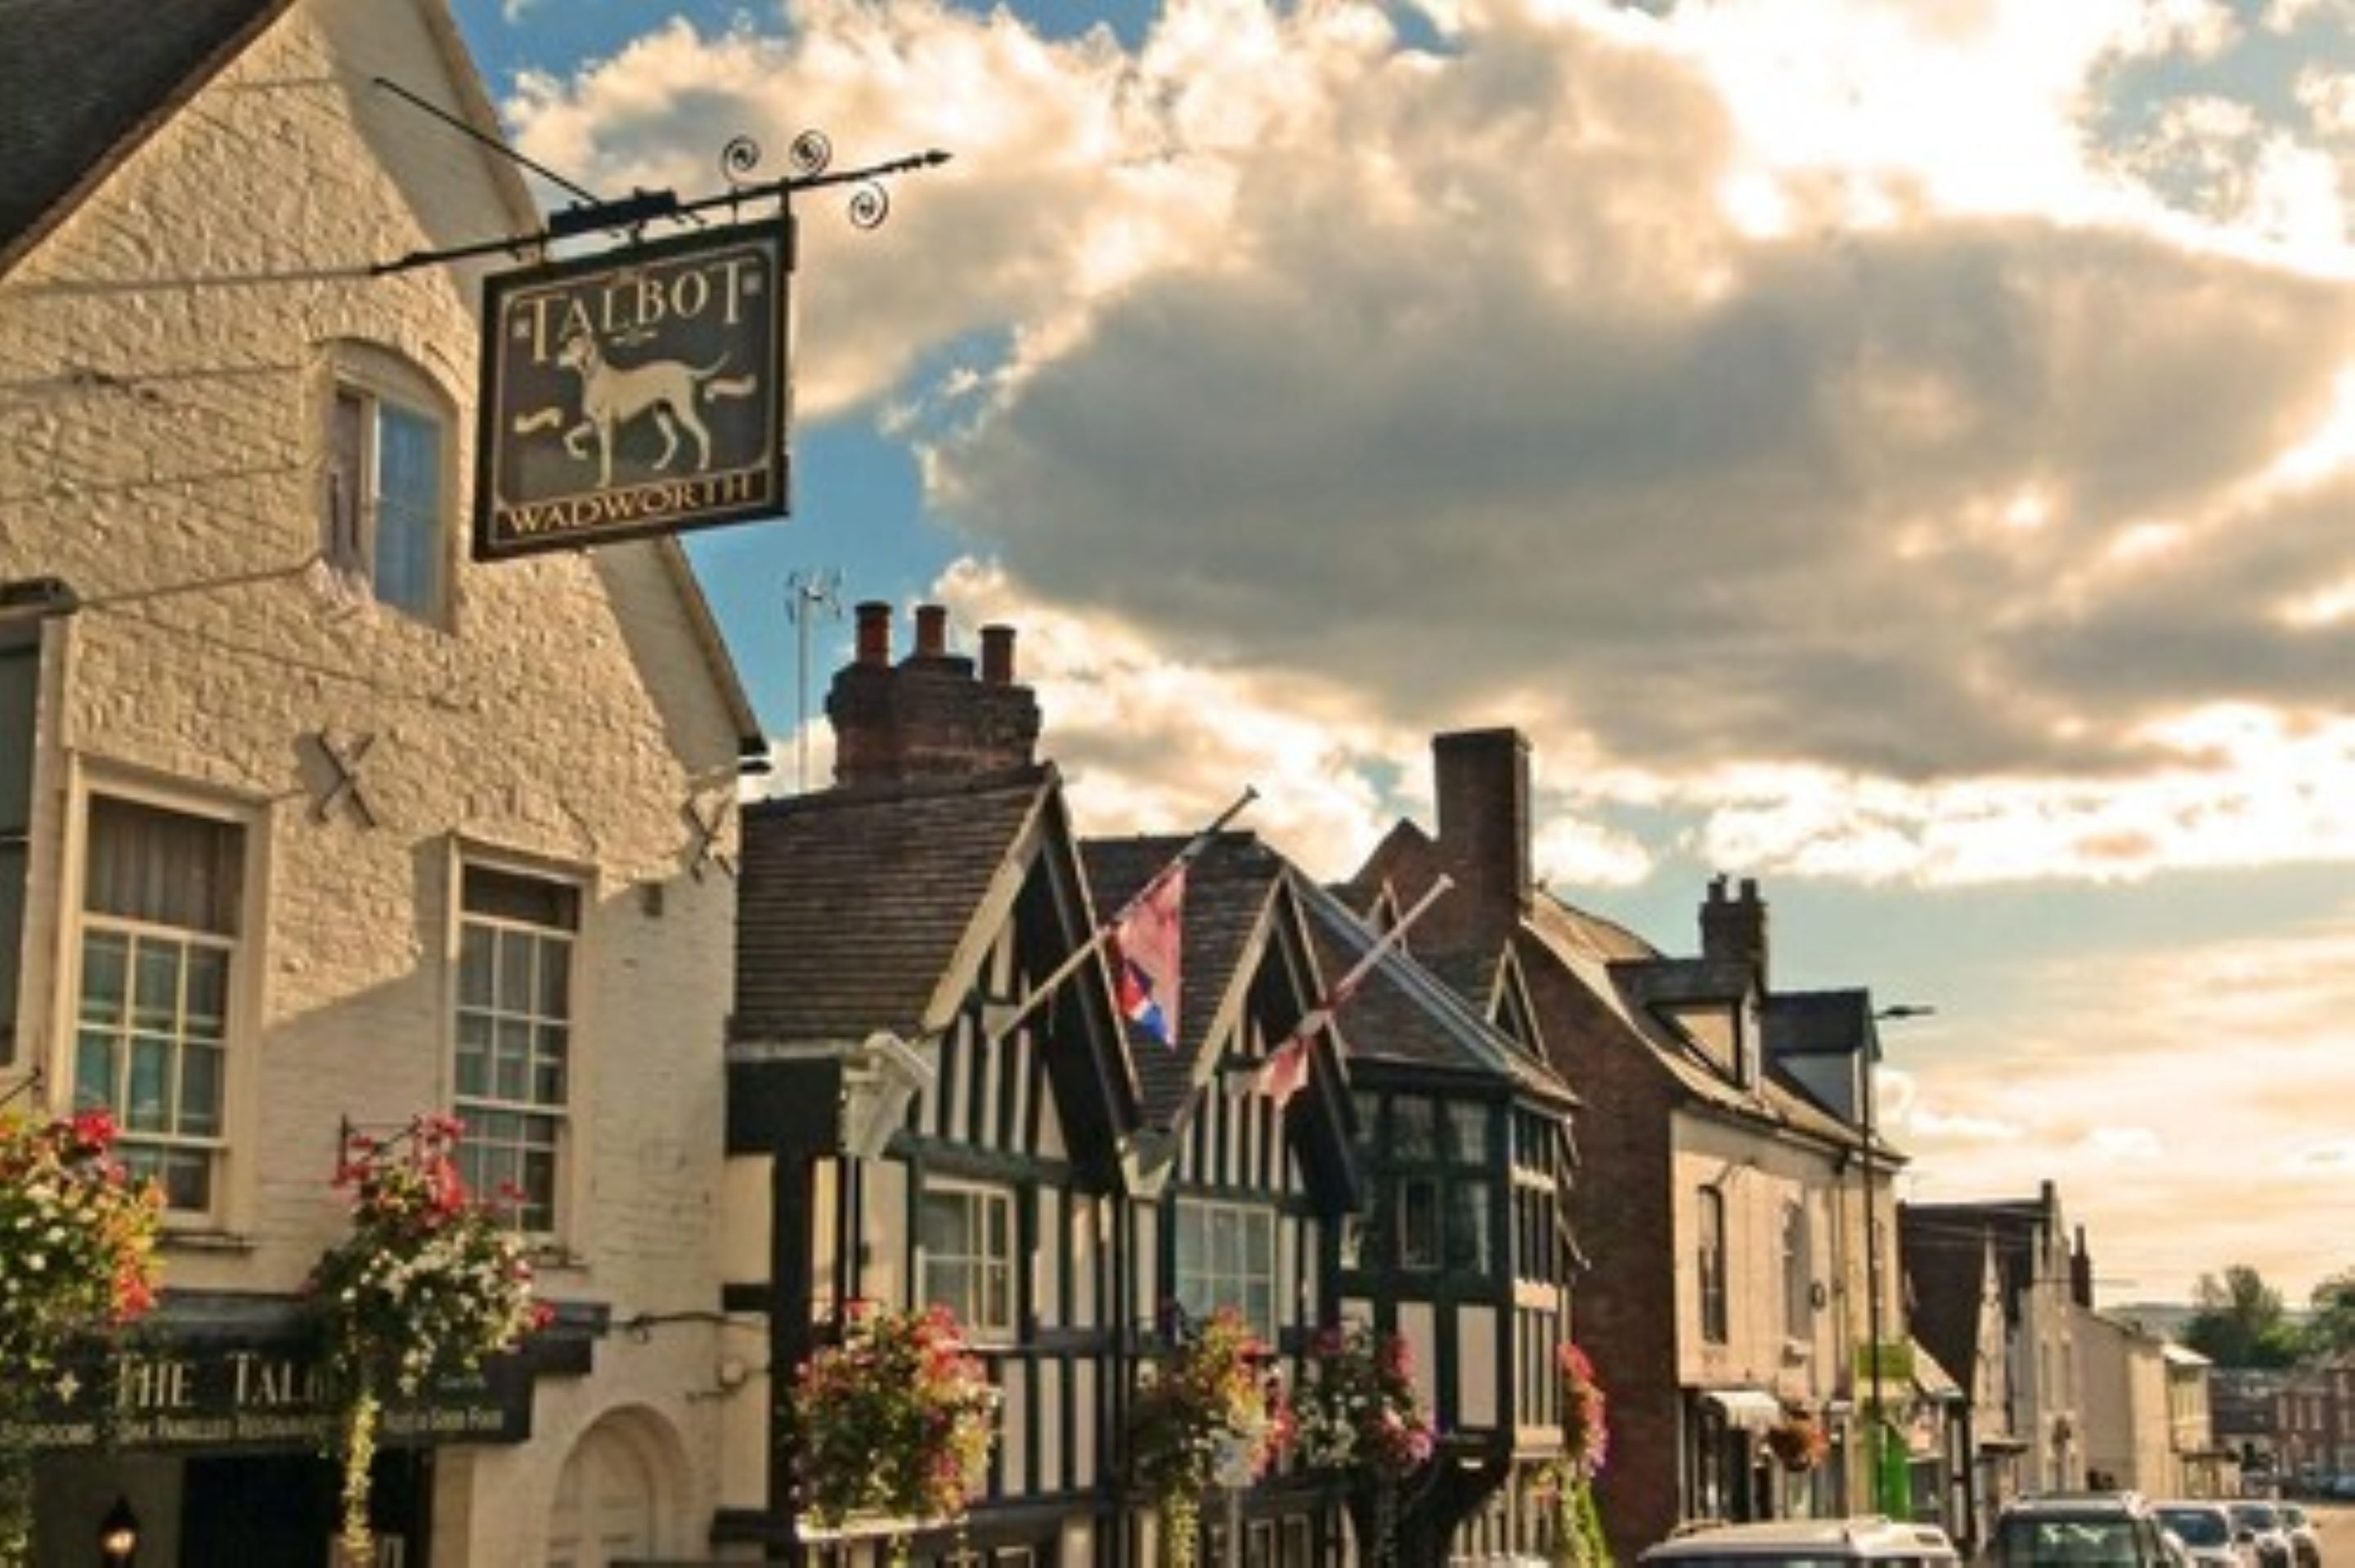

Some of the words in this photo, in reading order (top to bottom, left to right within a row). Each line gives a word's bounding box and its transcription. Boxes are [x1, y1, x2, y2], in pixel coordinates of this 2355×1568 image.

[515, 258, 755, 362] TALBOT
[509, 473, 751, 534] WADWORTH
[108, 1353, 195, 1408] THE
